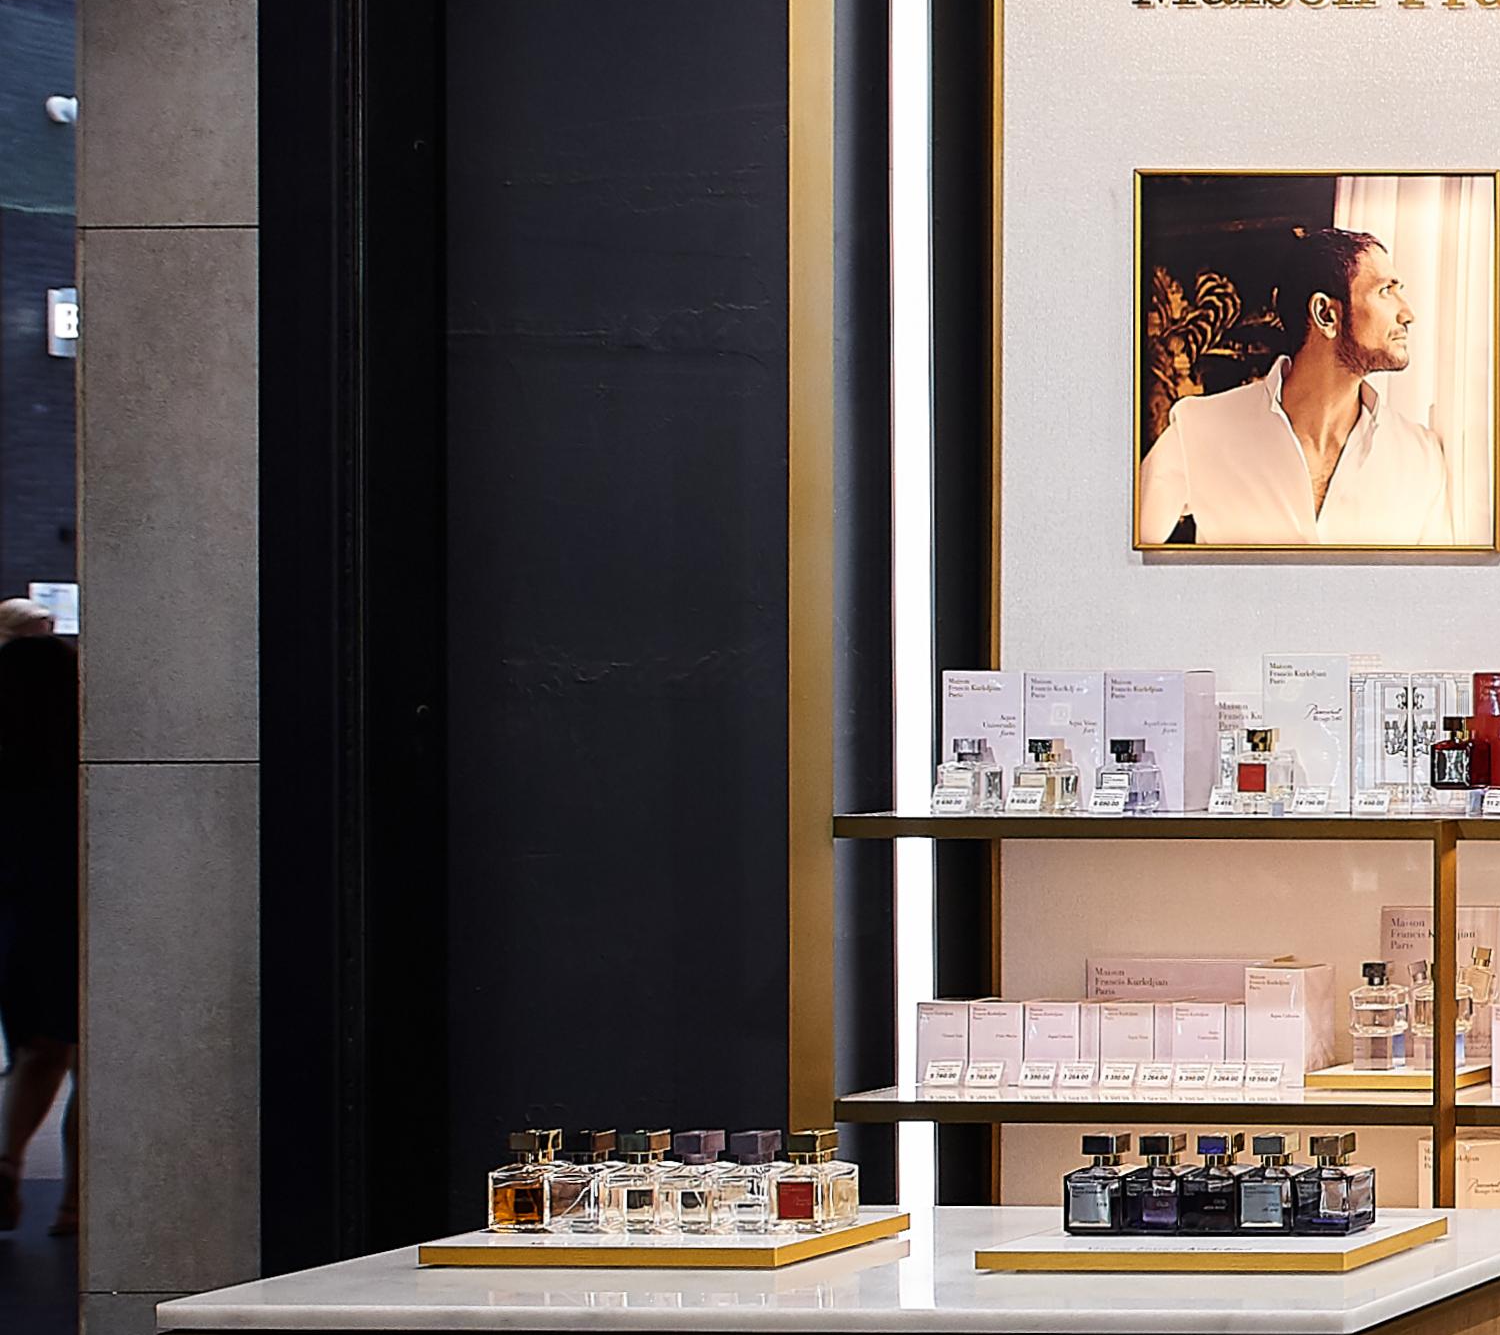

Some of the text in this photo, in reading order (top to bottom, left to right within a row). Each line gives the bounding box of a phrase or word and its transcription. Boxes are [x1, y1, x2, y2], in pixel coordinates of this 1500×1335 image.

[1390, 917, 1425, 928] Maison
[1390, 929, 1426, 939] Francis
[1390, 940, 1414, 950] Paris
[1095, 967, 1126, 976] Maison
[1095, 978, 1126, 986] Francis
[1095, 987, 1116, 996] Paris
